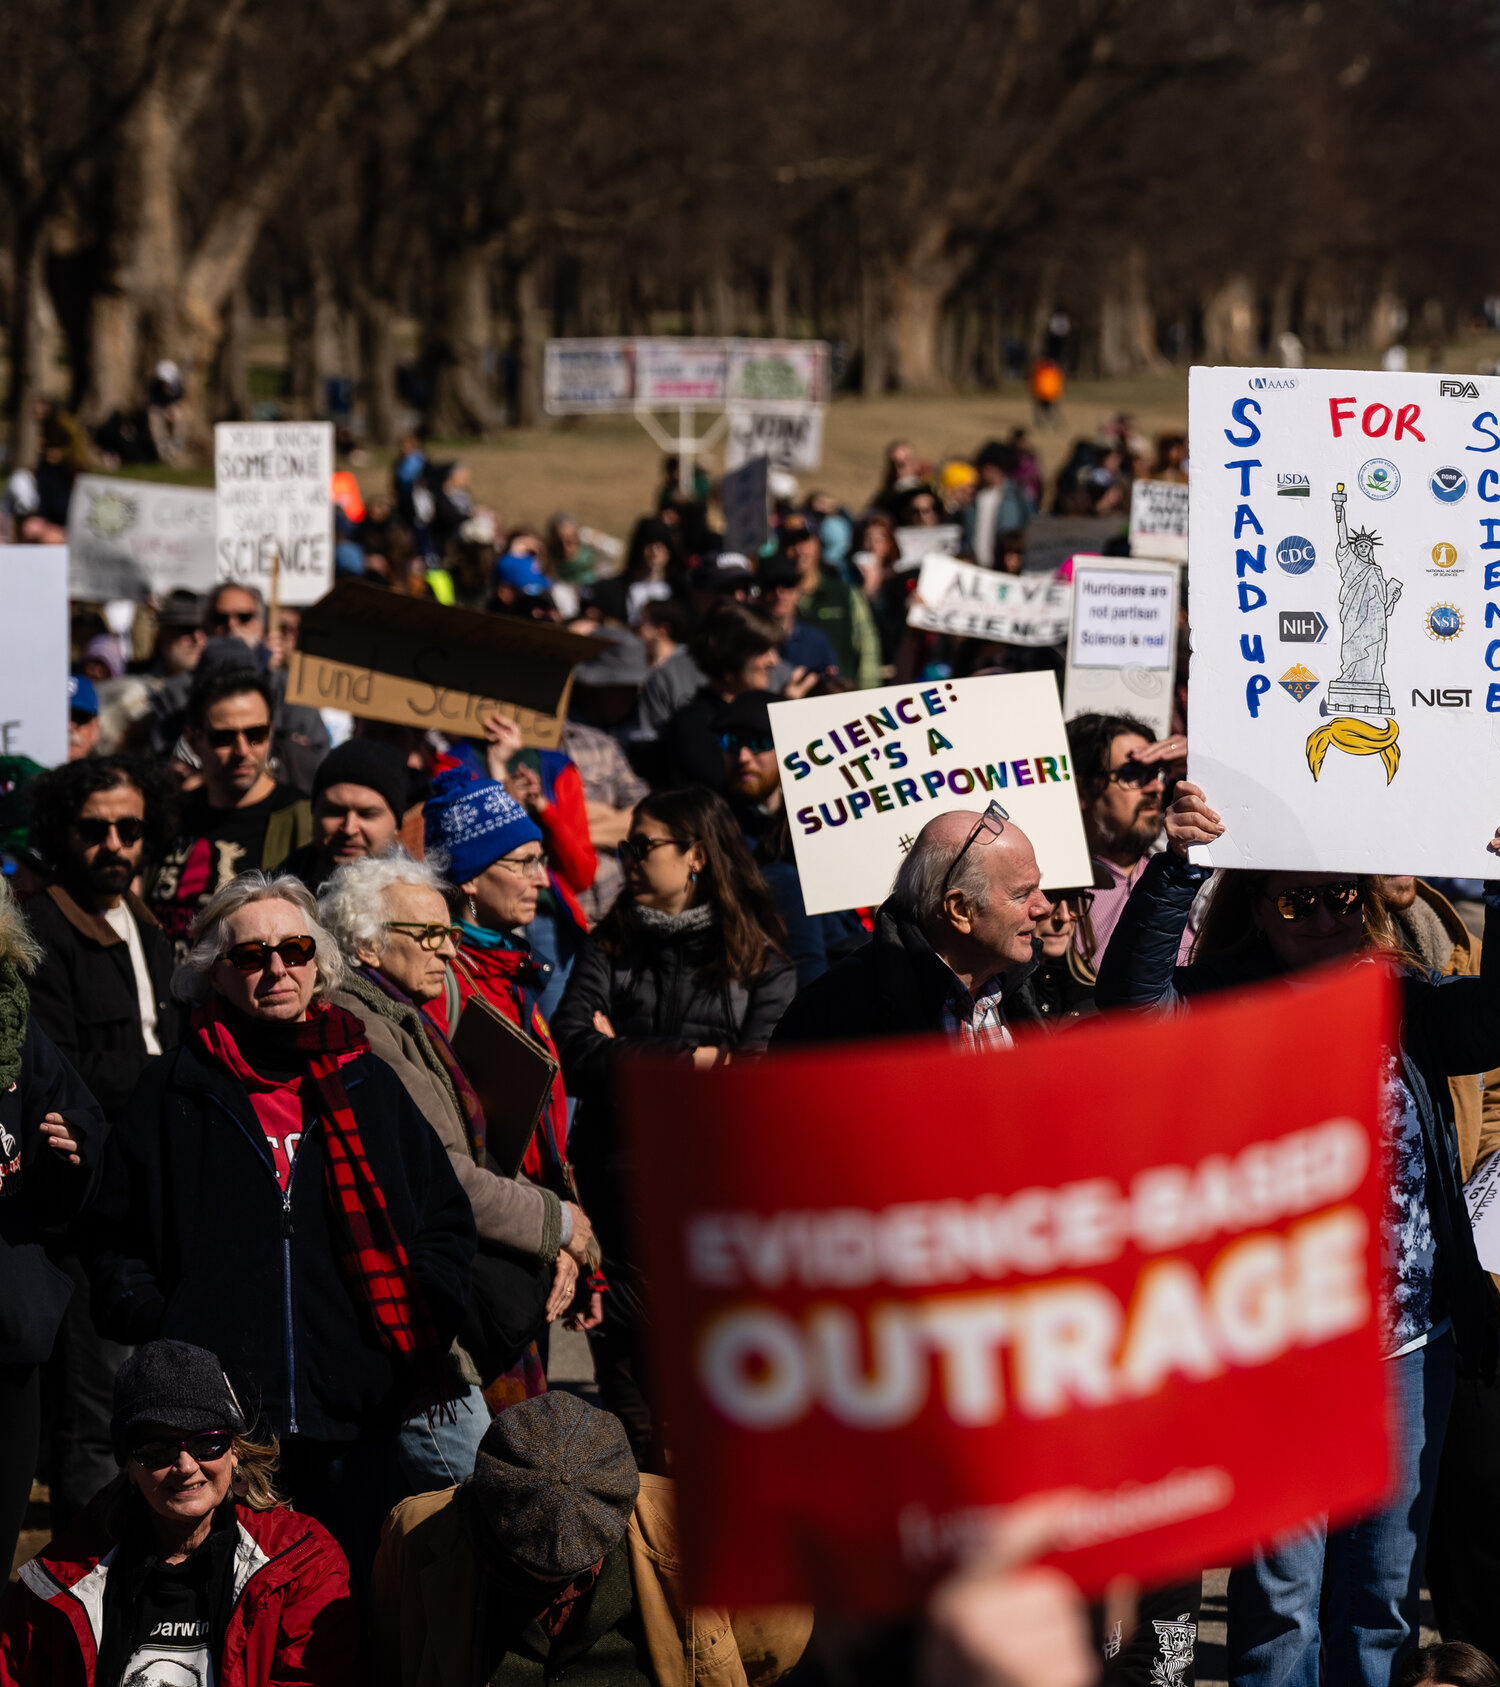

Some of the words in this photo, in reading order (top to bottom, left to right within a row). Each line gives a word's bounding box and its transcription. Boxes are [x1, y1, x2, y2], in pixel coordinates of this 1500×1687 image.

[1268, 380, 1295, 389] AAAS
[1440, 380, 1480, 398] FDA
[1329, 397, 1426, 442] FOR
[219, 452, 321, 481] SOMEONE
[1277, 474, 1310, 484] USDA
[1224, 397, 1268, 613] STAND
[218, 534, 326, 577] SCIENCE
[1278, 546, 1314, 564] CDC
[1082, 580, 1146, 598] Hurricanes
[1150, 586, 1168, 597] are
[921, 609, 1070, 638] SCIENCE
[1089, 603, 1108, 619] not
[1111, 605, 1158, 622] partisan
[1432, 615, 1459, 628] NSF
[1080, 631, 1126, 646] Science
[1129, 632, 1140, 646] is
[1142, 633, 1165, 646] real
[1283, 619, 1315, 635] NIH
[296, 629, 375, 705] Fund
[1412, 688, 1472, 707] NIST
[783, 683, 958, 780] SCIENCE:
[926, 727, 953, 756] A
[796, 755, 1070, 835] SUPERPOWER!
[684, 1116, 1371, 1288] EVIDENCE-BASED
[1469, 1186, 1486, 1200] to
[697, 1205, 1371, 1432] OUTRAGE
